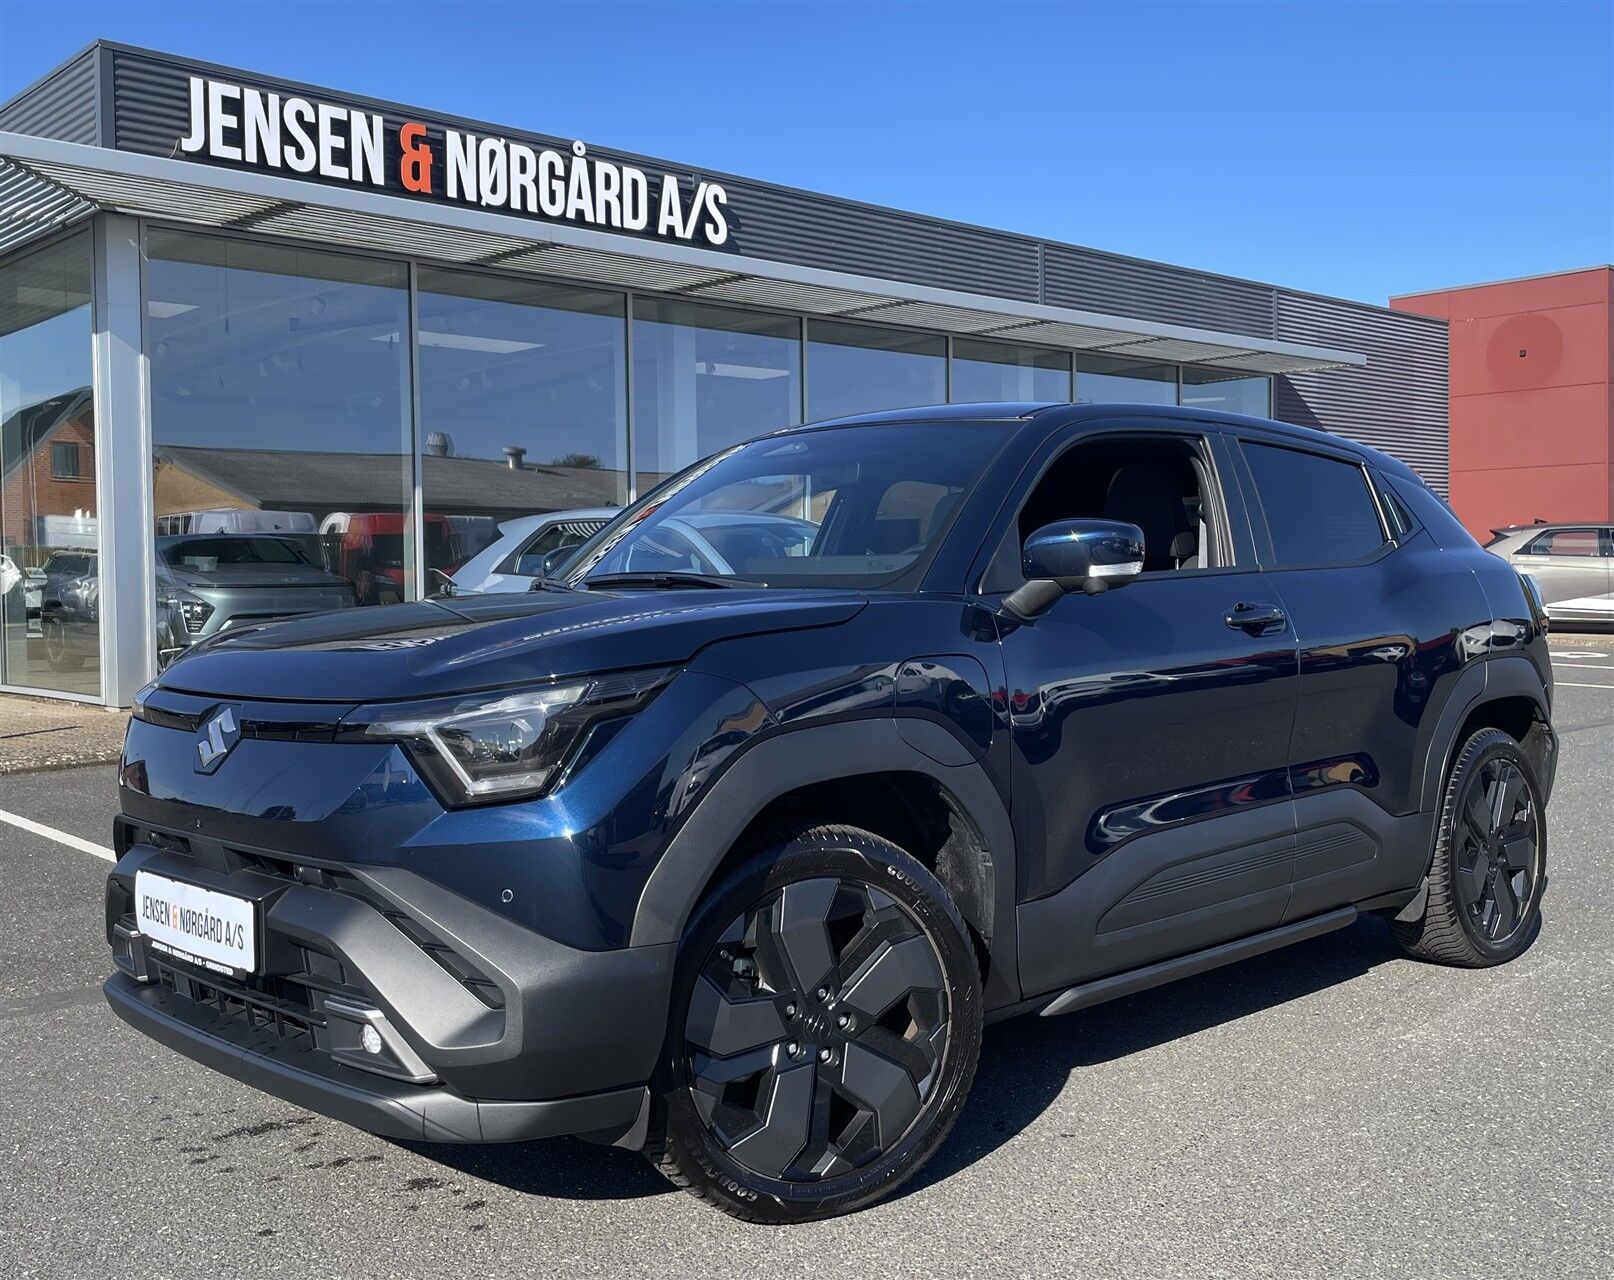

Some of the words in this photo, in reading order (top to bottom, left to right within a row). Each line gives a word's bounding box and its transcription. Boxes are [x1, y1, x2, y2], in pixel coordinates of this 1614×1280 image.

[181, 76, 385, 186] JENSEN
[399, 122, 433, 195] &
[446, 129, 648, 231] NØRGÅRD
[657, 174, 728, 245] A/S
[142, 895, 171, 927] JENSEN
[172, 905, 178, 929] &
[179, 907, 223, 944] NØRGÅRD
[225, 921, 244, 950] A/S
